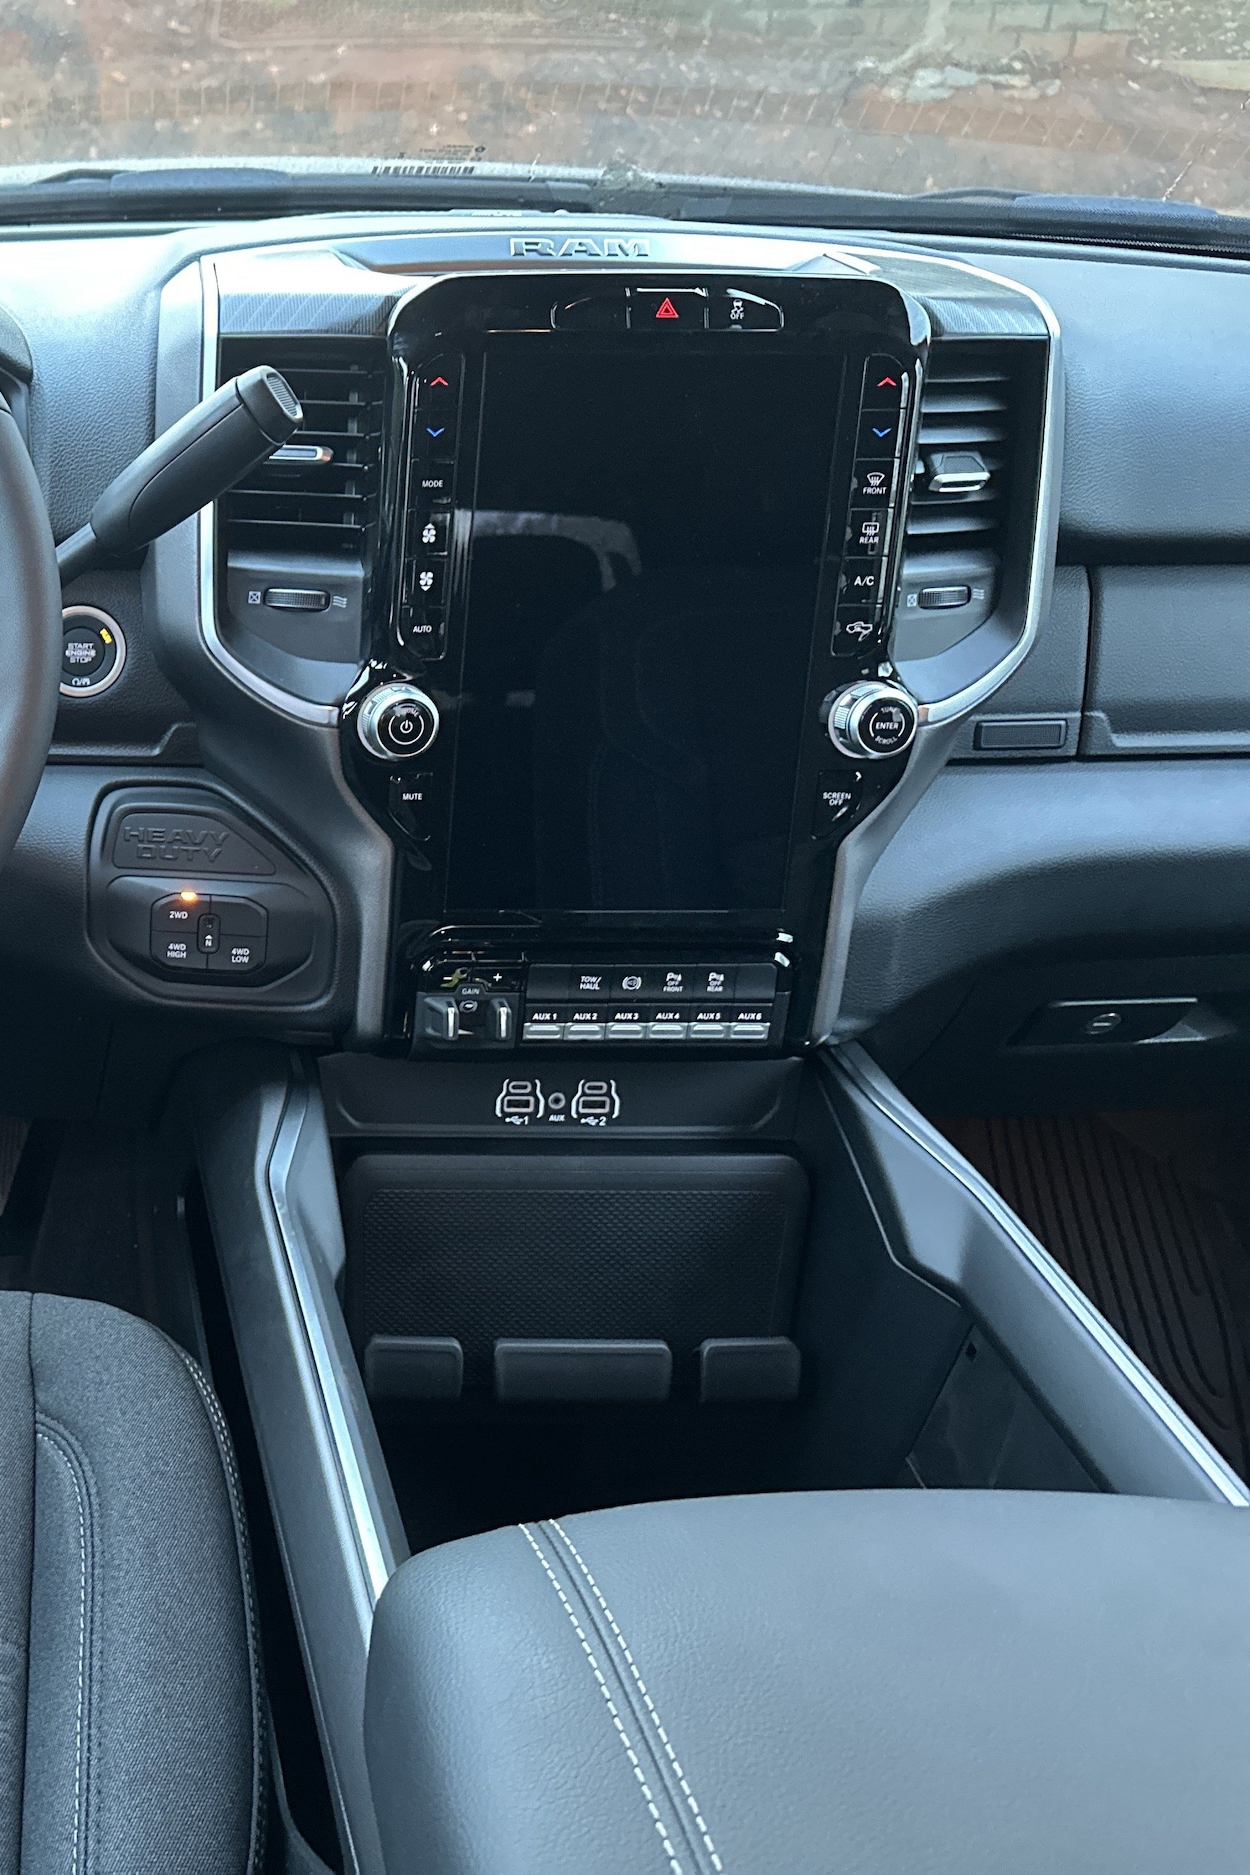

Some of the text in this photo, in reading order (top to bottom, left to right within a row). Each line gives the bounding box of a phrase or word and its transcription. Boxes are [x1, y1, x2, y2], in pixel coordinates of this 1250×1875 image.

[510, 237, 650, 257] RAM
[729, 312, 745, 321] OFF
[422, 480, 443, 488] MODE
[862, 487, 886, 495] FRONT
[859, 536, 879, 544] REAR
[854, 576, 875, 586] A/C
[413, 625, 432, 633] AUTO
[68, 642, 94, 650] START
[70, 656, 92, 664] STOP
[875, 722, 899, 730] ENTER
[875, 736, 898, 745] SCROLL
[402, 793, 423, 801] MUTE
[822, 792, 851, 800] SCREEN
[123, 826, 231, 844] HEAVY
[137, 844, 223, 862] DUTY
[169, 910, 188, 920] 2WD
[168, 943, 187, 951] 4WD
[166, 950, 187, 959] HIGH
[231, 948, 250, 956] 4WD
[231, 955, 249, 964] LOW
[461, 987, 480, 995] GAIN
[549, 1114, 566, 1122] AUX
[599, 1116, 606, 1126] 2
